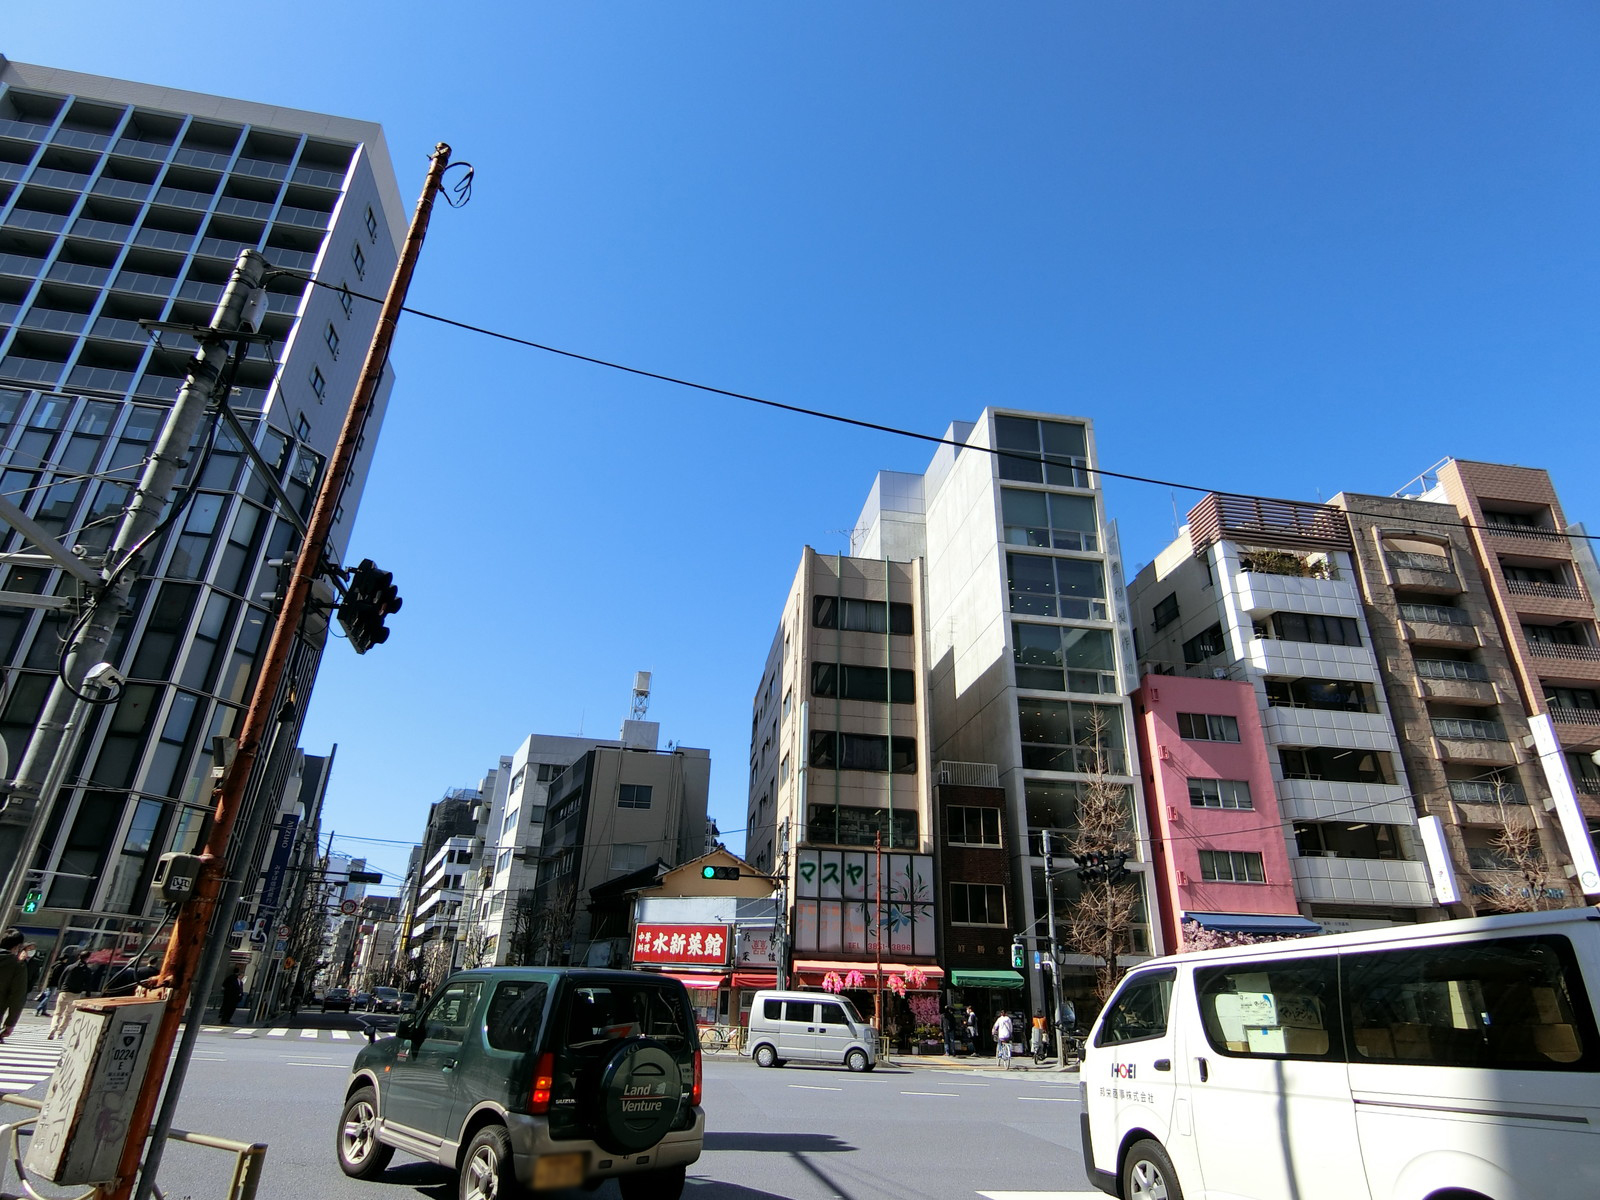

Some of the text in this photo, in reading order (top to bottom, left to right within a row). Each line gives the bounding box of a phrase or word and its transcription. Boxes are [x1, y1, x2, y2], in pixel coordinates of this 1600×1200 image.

[799, 862, 863, 886] マスヤ
[638, 932, 651, 942] 中華
[652, 932, 723, 957] 水新菜館
[113, 1049, 135, 1061] 0224
[1111, 1062, 1137, 1079] HOEI
[624, 1083, 651, 1096] Land
[622, 1100, 662, 1112] Venture
